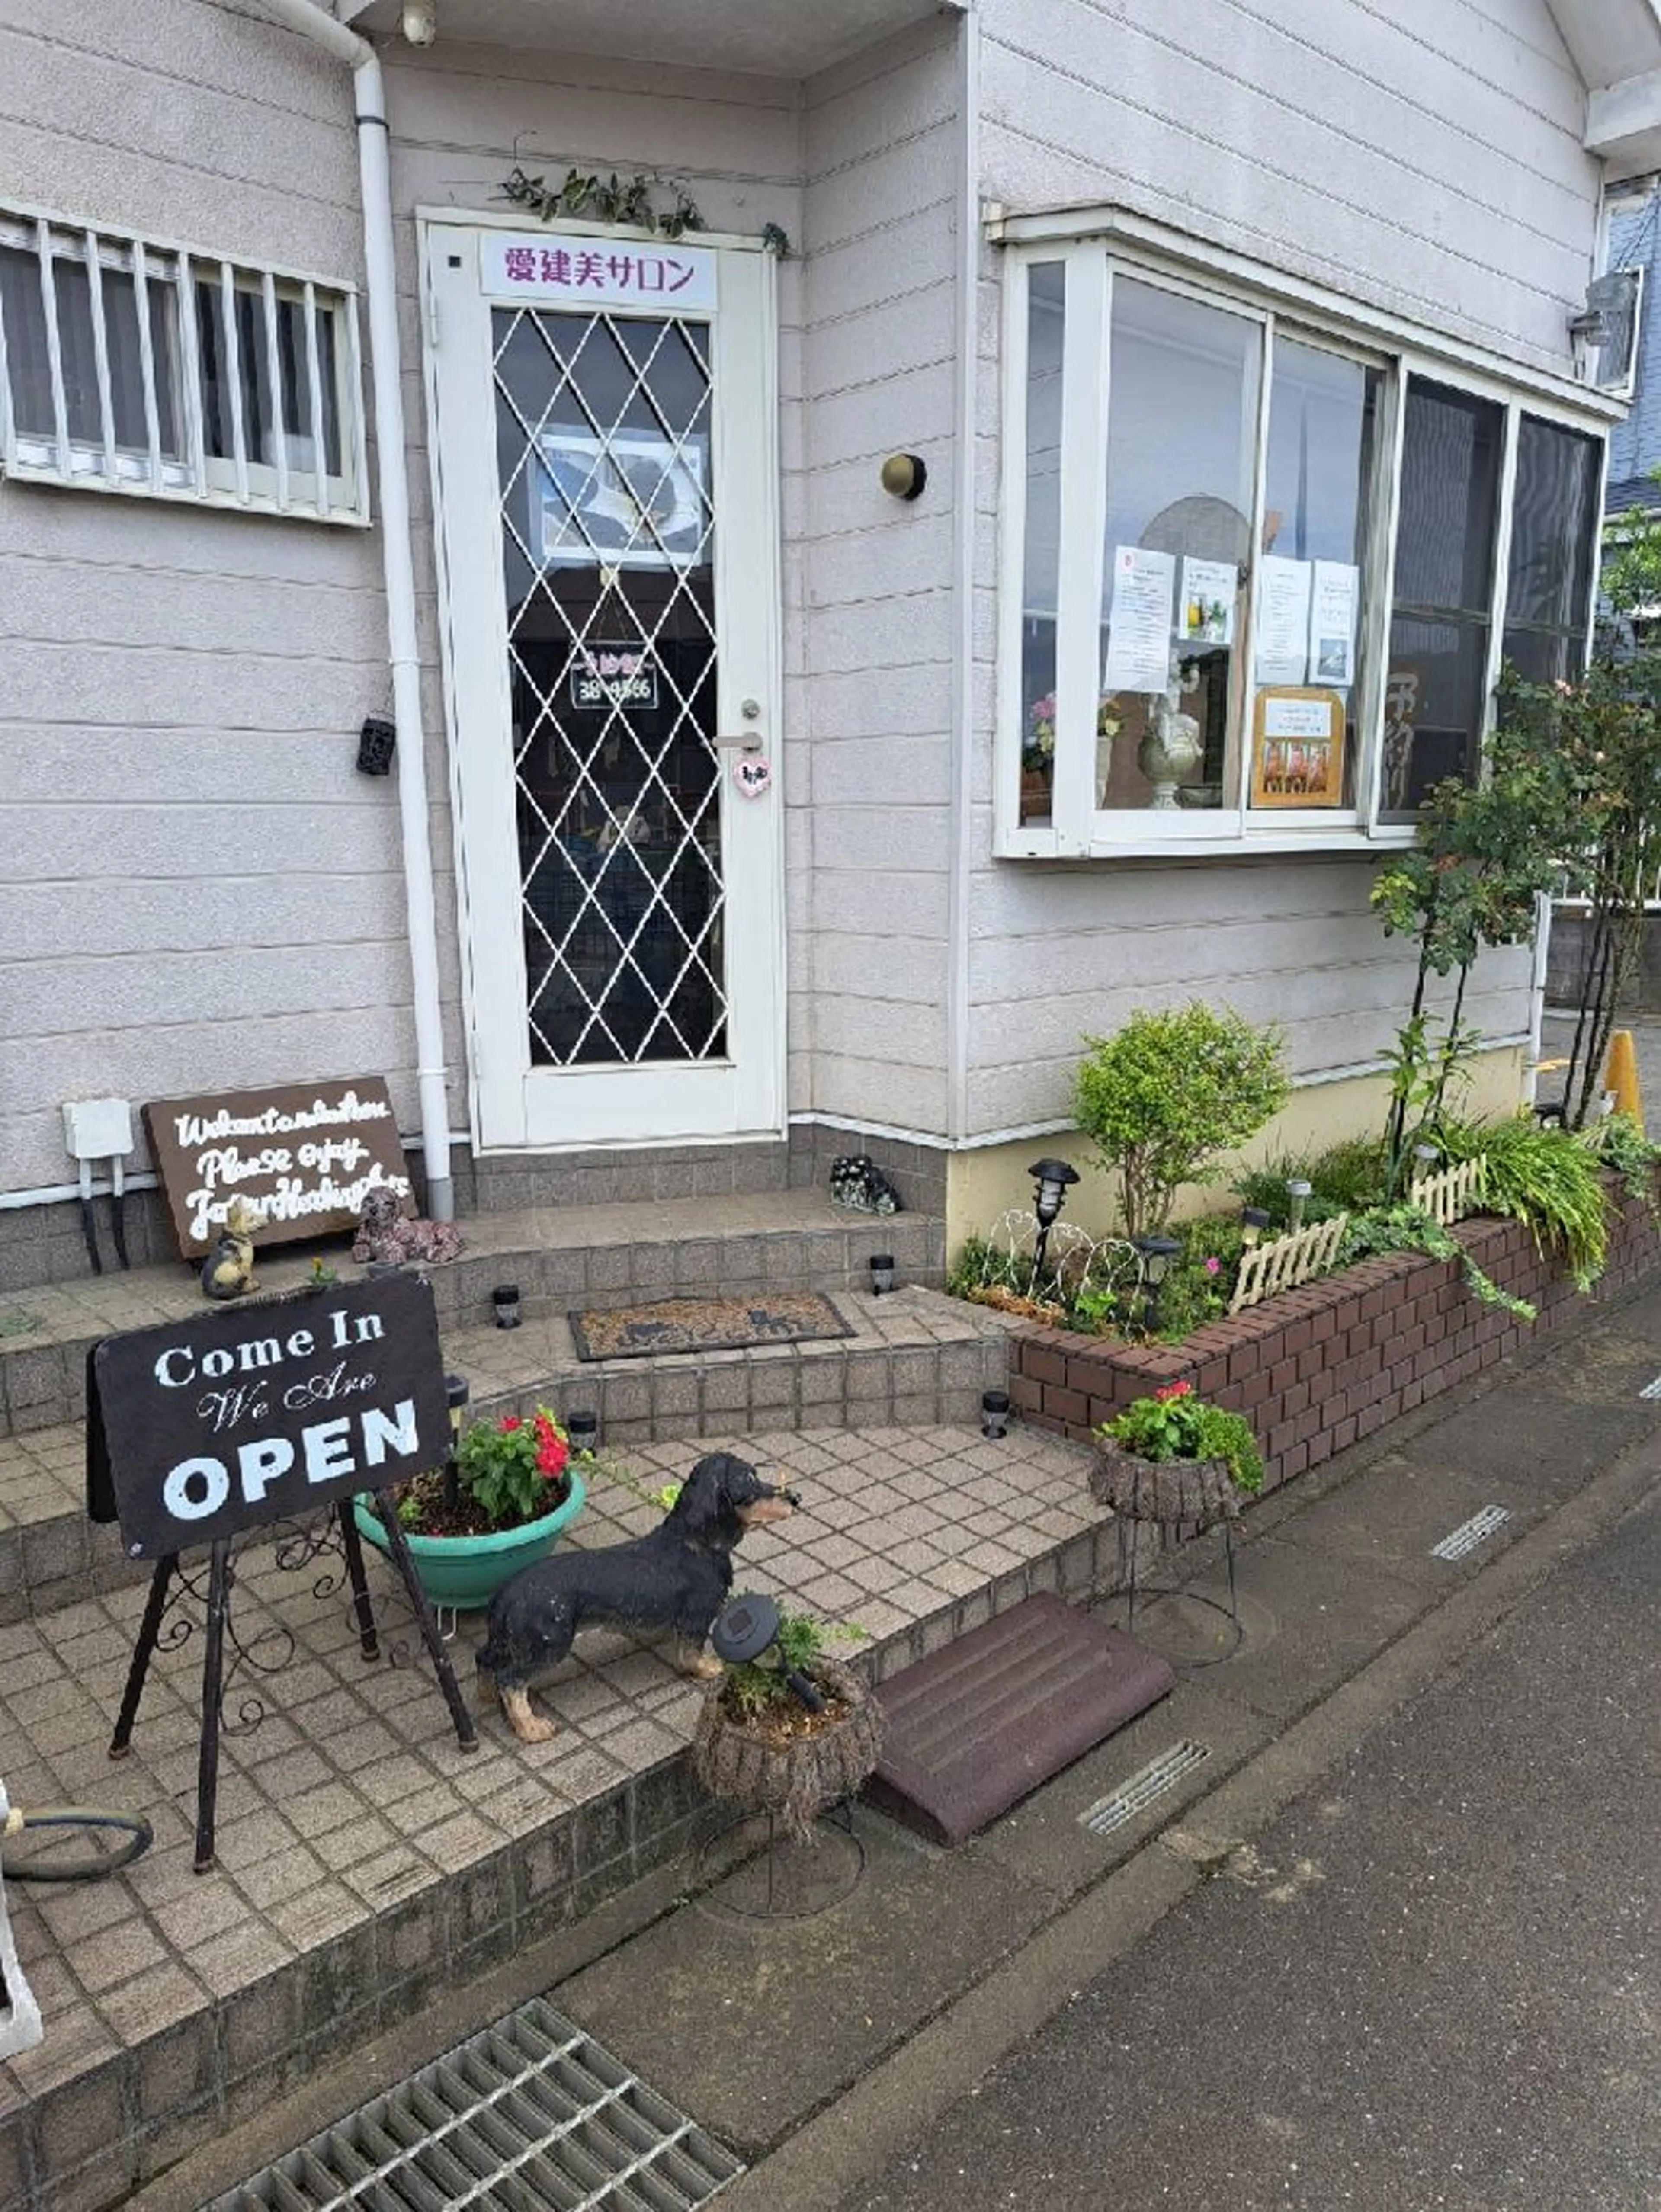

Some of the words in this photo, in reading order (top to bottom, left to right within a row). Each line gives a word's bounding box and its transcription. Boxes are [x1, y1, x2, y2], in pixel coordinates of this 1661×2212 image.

[504, 247, 695, 292] 愛建美サロン
[154, 1329, 315, 1388] Come
[329, 1310, 386, 1350] In
[196, 1381, 269, 1432] We
[283, 1361, 377, 1410] Are
[163, 1398, 420, 1521] OPEN
